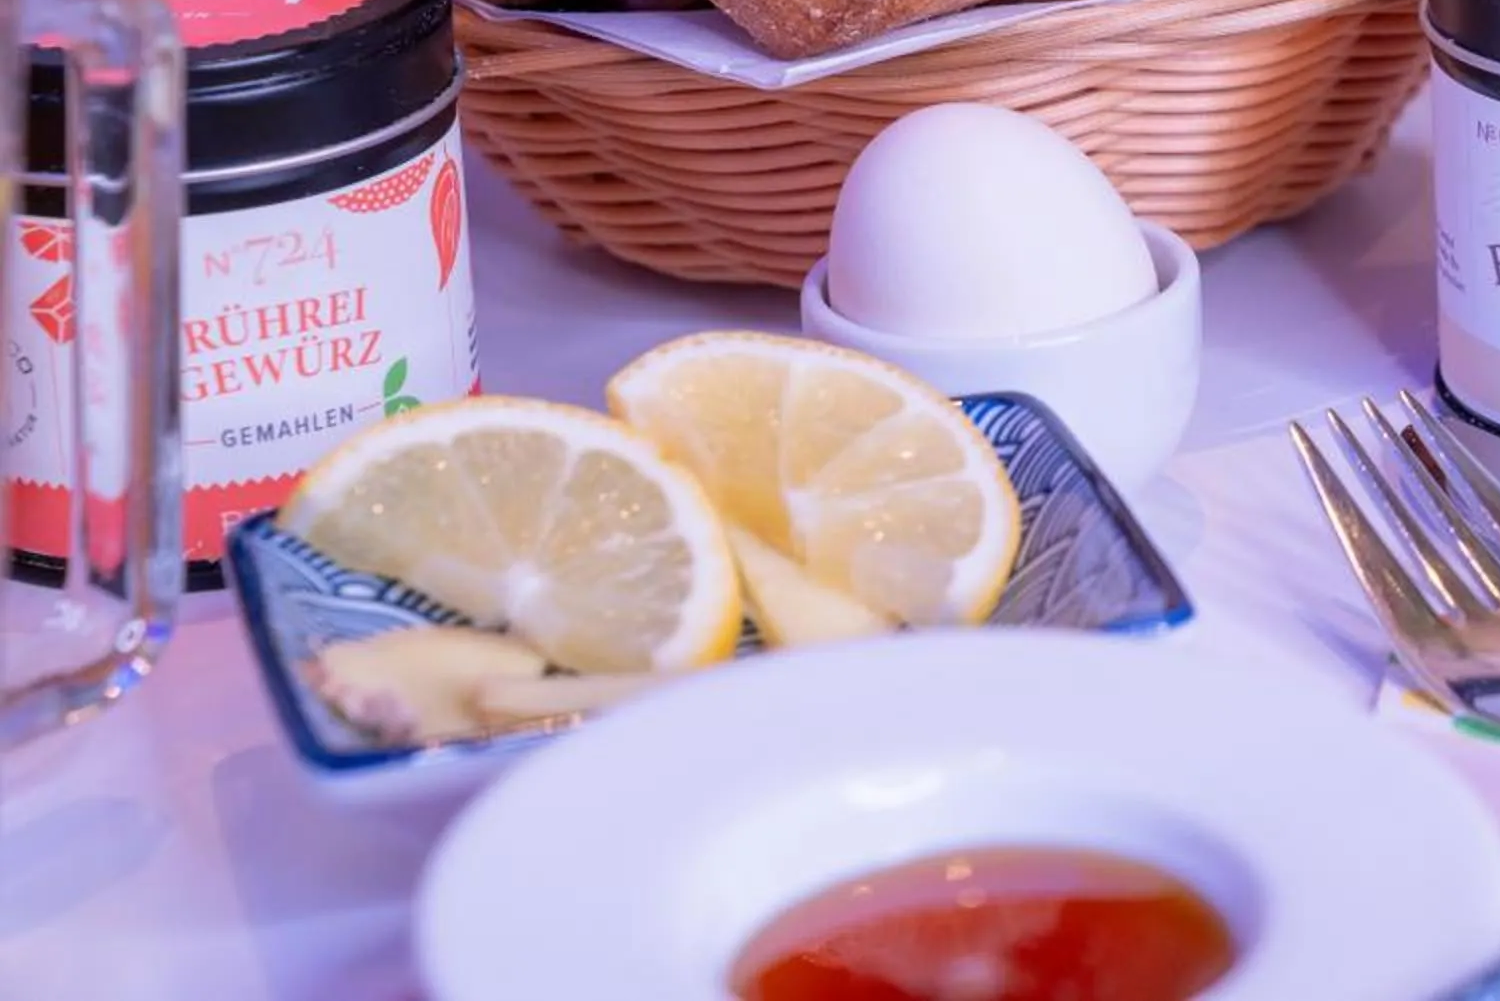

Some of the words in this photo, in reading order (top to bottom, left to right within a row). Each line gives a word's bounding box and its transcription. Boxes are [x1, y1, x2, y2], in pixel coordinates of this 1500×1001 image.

[180, 286, 368, 355] RÜHREI
[178, 329, 383, 403] GEWÜRZ
[220, 403, 354, 448] GEMAHLEN
